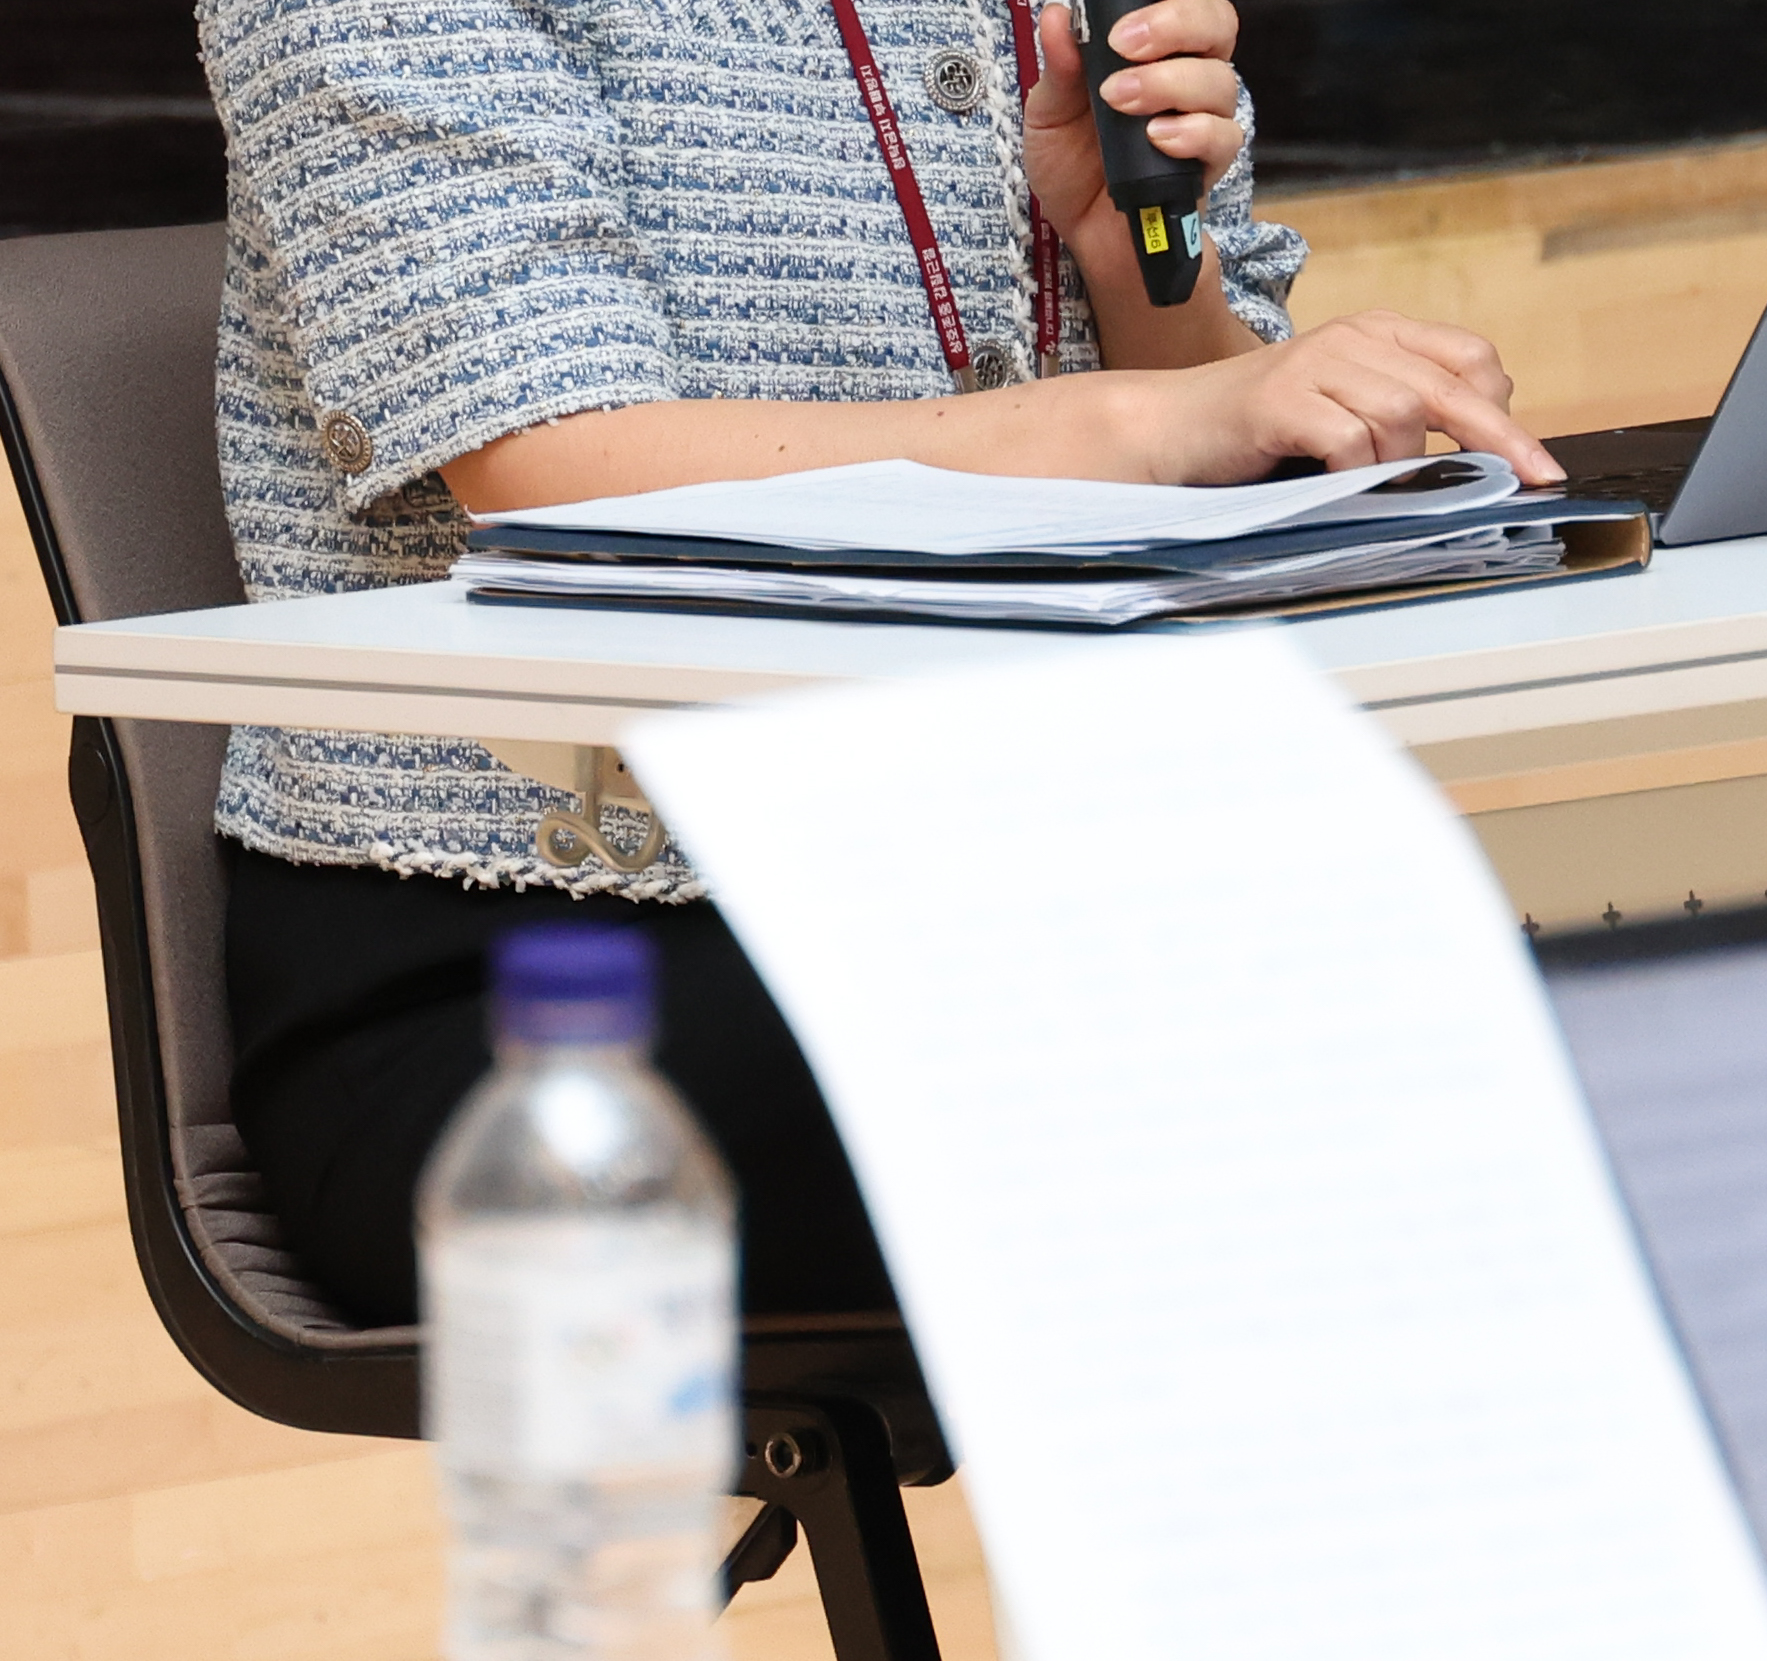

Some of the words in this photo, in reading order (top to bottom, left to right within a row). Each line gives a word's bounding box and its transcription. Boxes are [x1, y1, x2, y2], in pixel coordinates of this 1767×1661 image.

[860, 64, 887, 117] 부패방지
[879, 118, 906, 171] 청탁금지
[921, 247, 948, 301] 갑질근절
[938, 302, 964, 355] 상호존중
